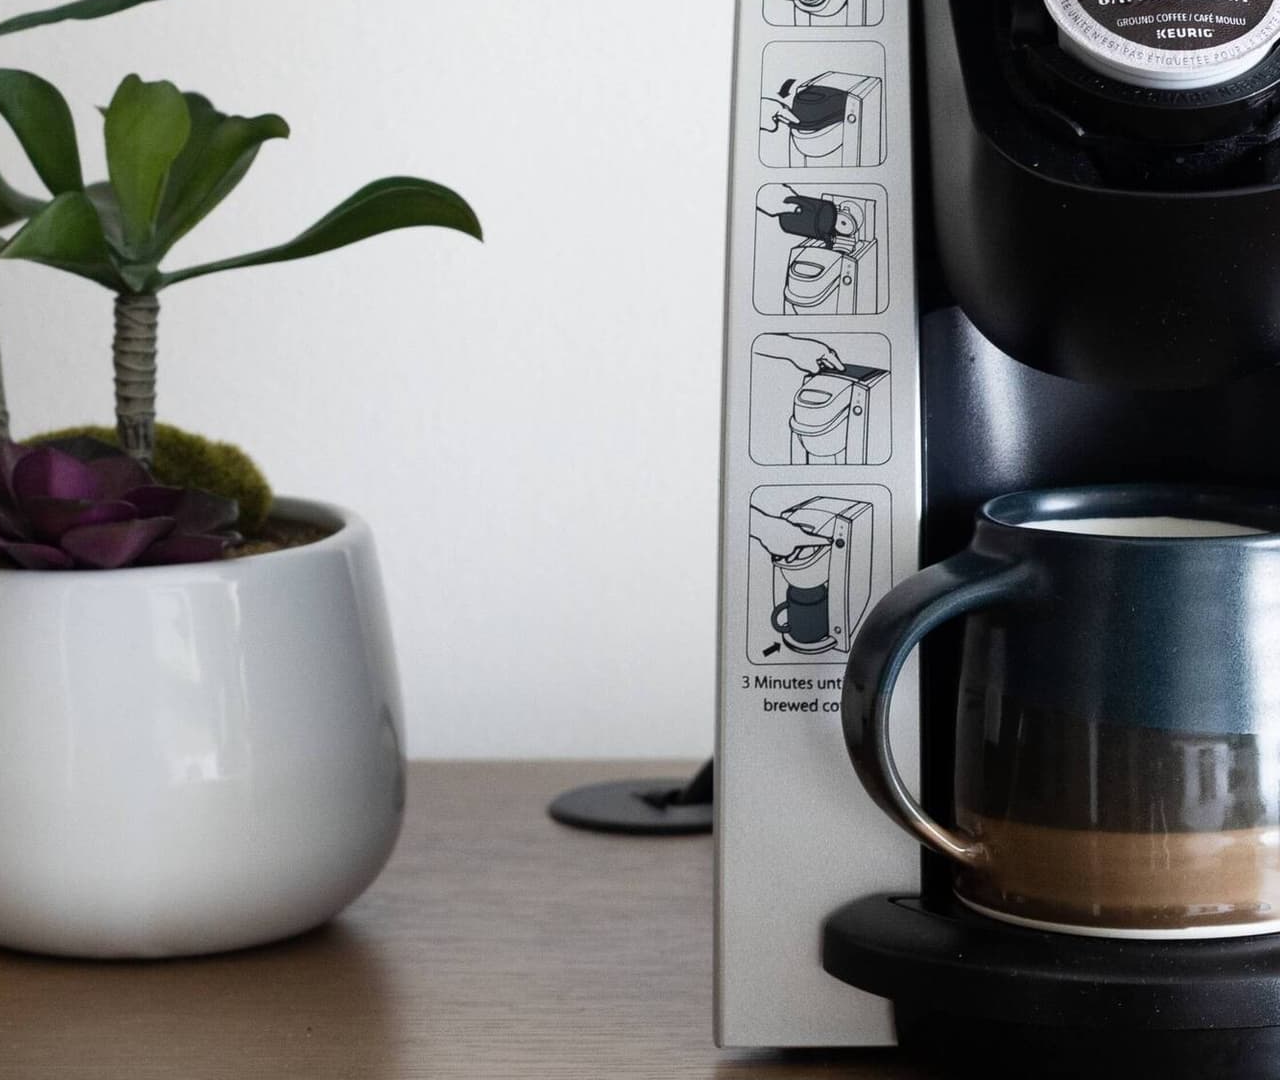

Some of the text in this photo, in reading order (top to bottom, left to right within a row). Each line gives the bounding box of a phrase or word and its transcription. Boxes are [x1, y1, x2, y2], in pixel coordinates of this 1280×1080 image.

[1116, 15, 1155, 27] GROUND
[1156, 13, 1188, 24] COFFEE
[1194, 12, 1215, 24] CAFÉ
[1215, 15, 1247, 26] MOULU
[1156, 28, 1213, 39] KEURIG
[741, 675, 844, 690] 3 Minutes unt
[763, 698, 818, 712] brewed
